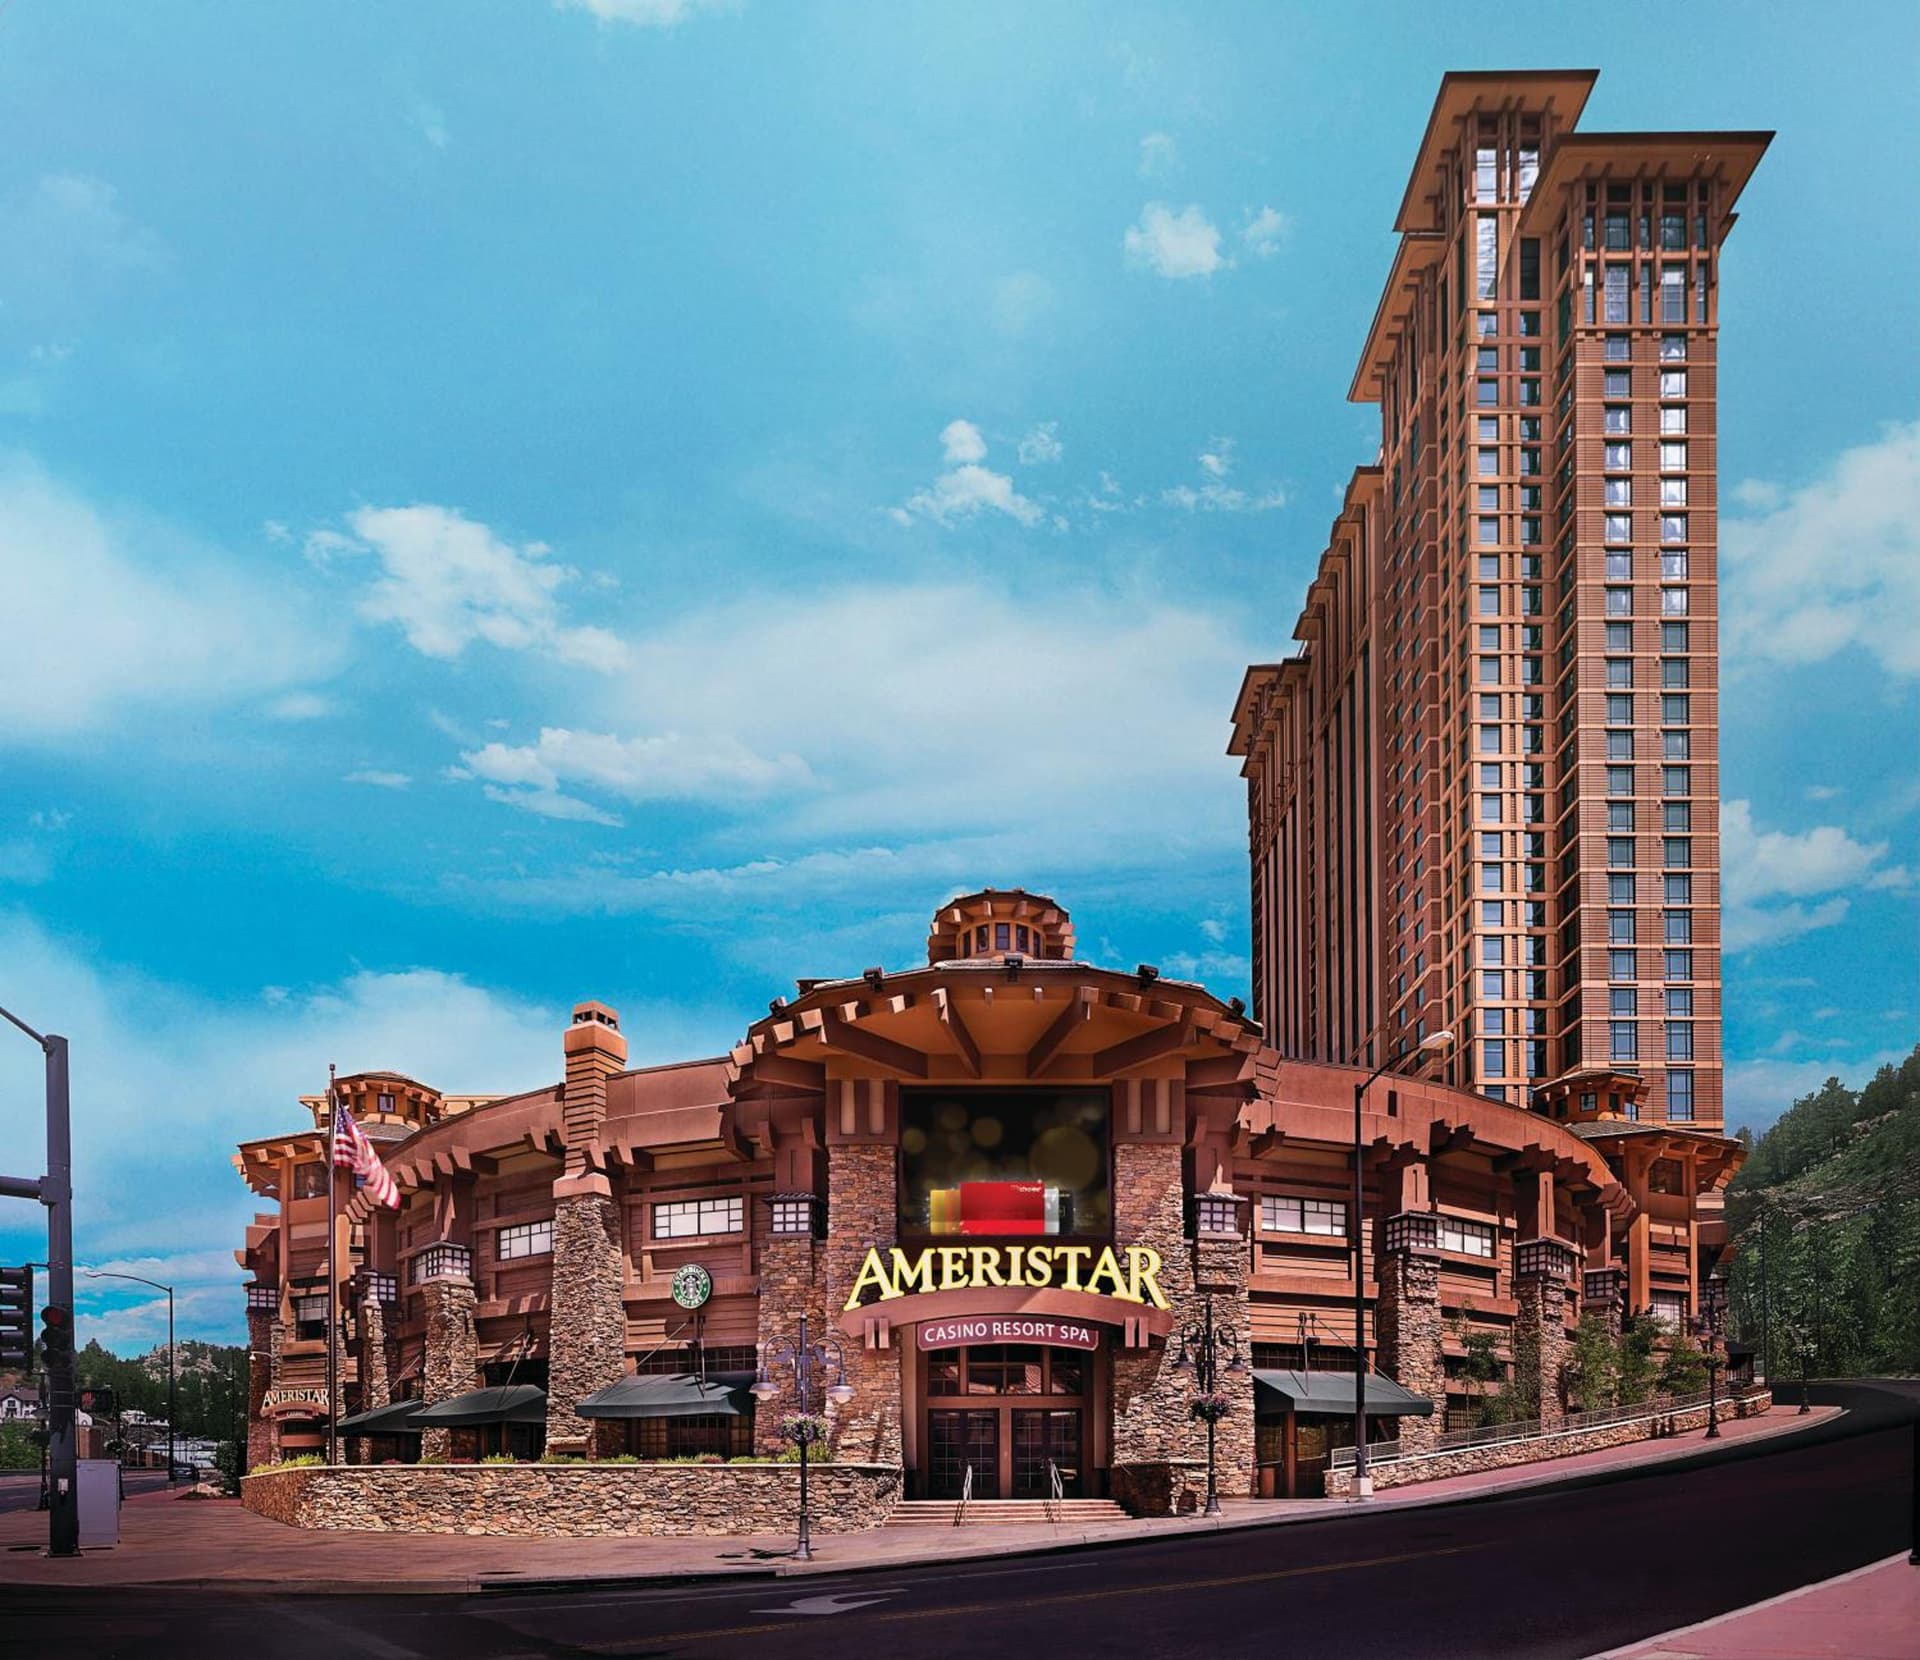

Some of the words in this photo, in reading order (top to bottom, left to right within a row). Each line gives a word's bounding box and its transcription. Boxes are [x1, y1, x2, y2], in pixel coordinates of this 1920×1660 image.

[843, 1246, 1172, 1311] AMERISTAR
[924, 1322, 987, 1342] CASINO
[992, 1322, 1055, 1337] RESORT
[1060, 1325, 1089, 1342] SPA
[261, 1388, 329, 1409] AMERISTAR
